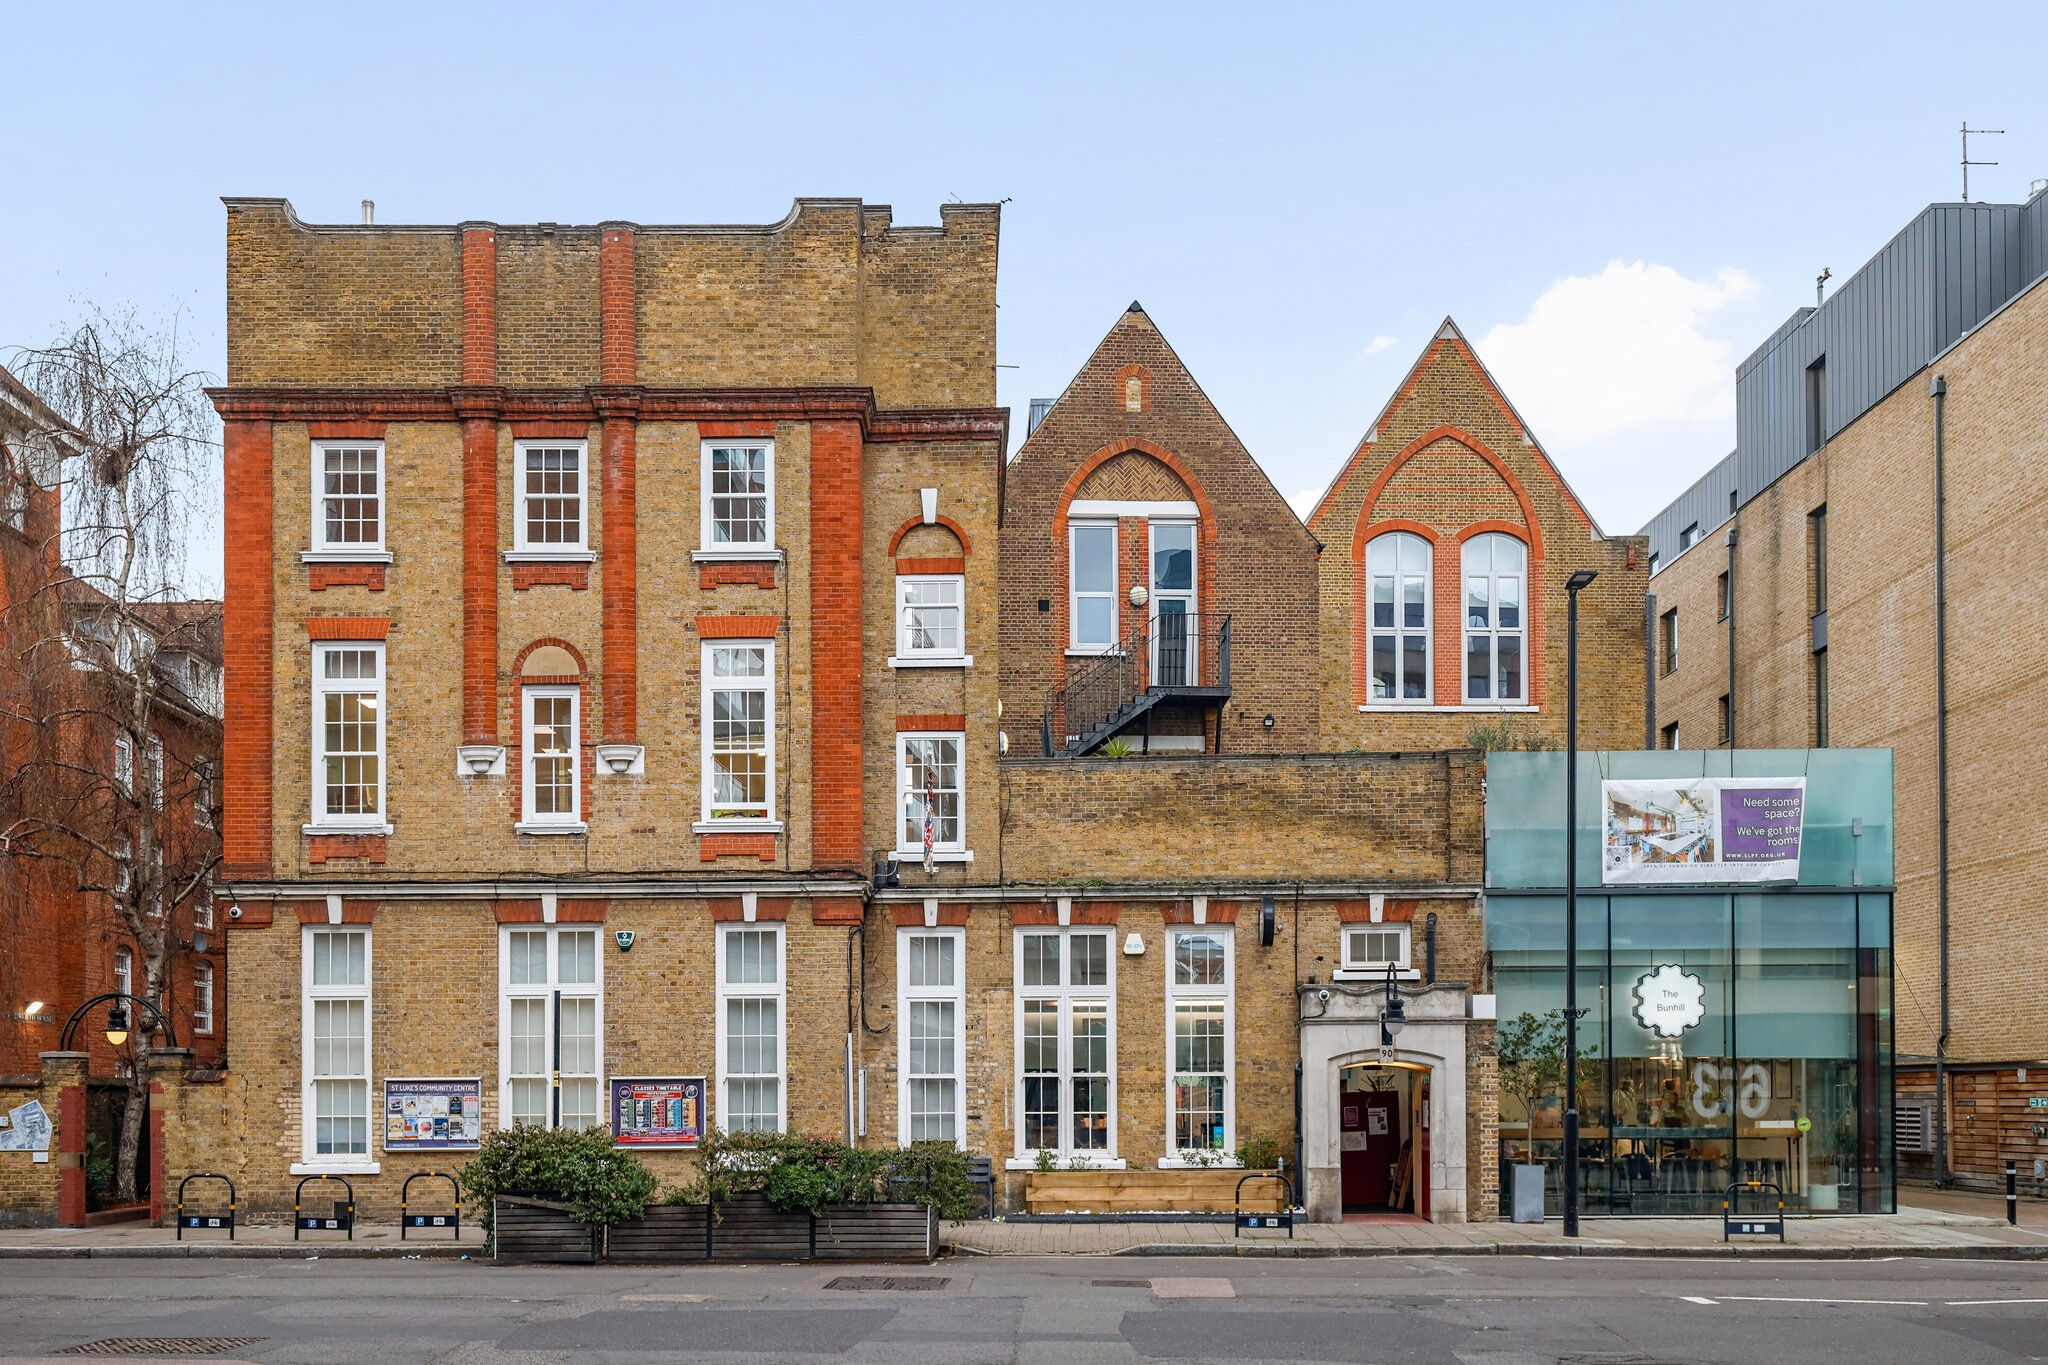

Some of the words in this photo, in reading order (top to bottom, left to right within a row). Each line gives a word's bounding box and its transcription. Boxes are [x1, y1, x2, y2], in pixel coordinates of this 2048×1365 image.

[1743, 797, 1770, 807] Need
[1772, 798, 1800, 807] some
[1764, 807, 1801, 820] space?
[1736, 826, 1765, 836] We've
[1767, 827, 1782, 837] got
[1785, 825, 1800, 834] the
[1662, 989, 1679, 998] The
[1656, 1003, 1686, 1012] Bunhill
[1381, 1049, 1393, 1058] 90
[391, 1084, 398, 1092] ST
[399, 1084, 418, 1092] LUKE'S
[419, 1084, 452, 1092] COMMUNITY
[453, 1084, 476, 1092] CENTRE
